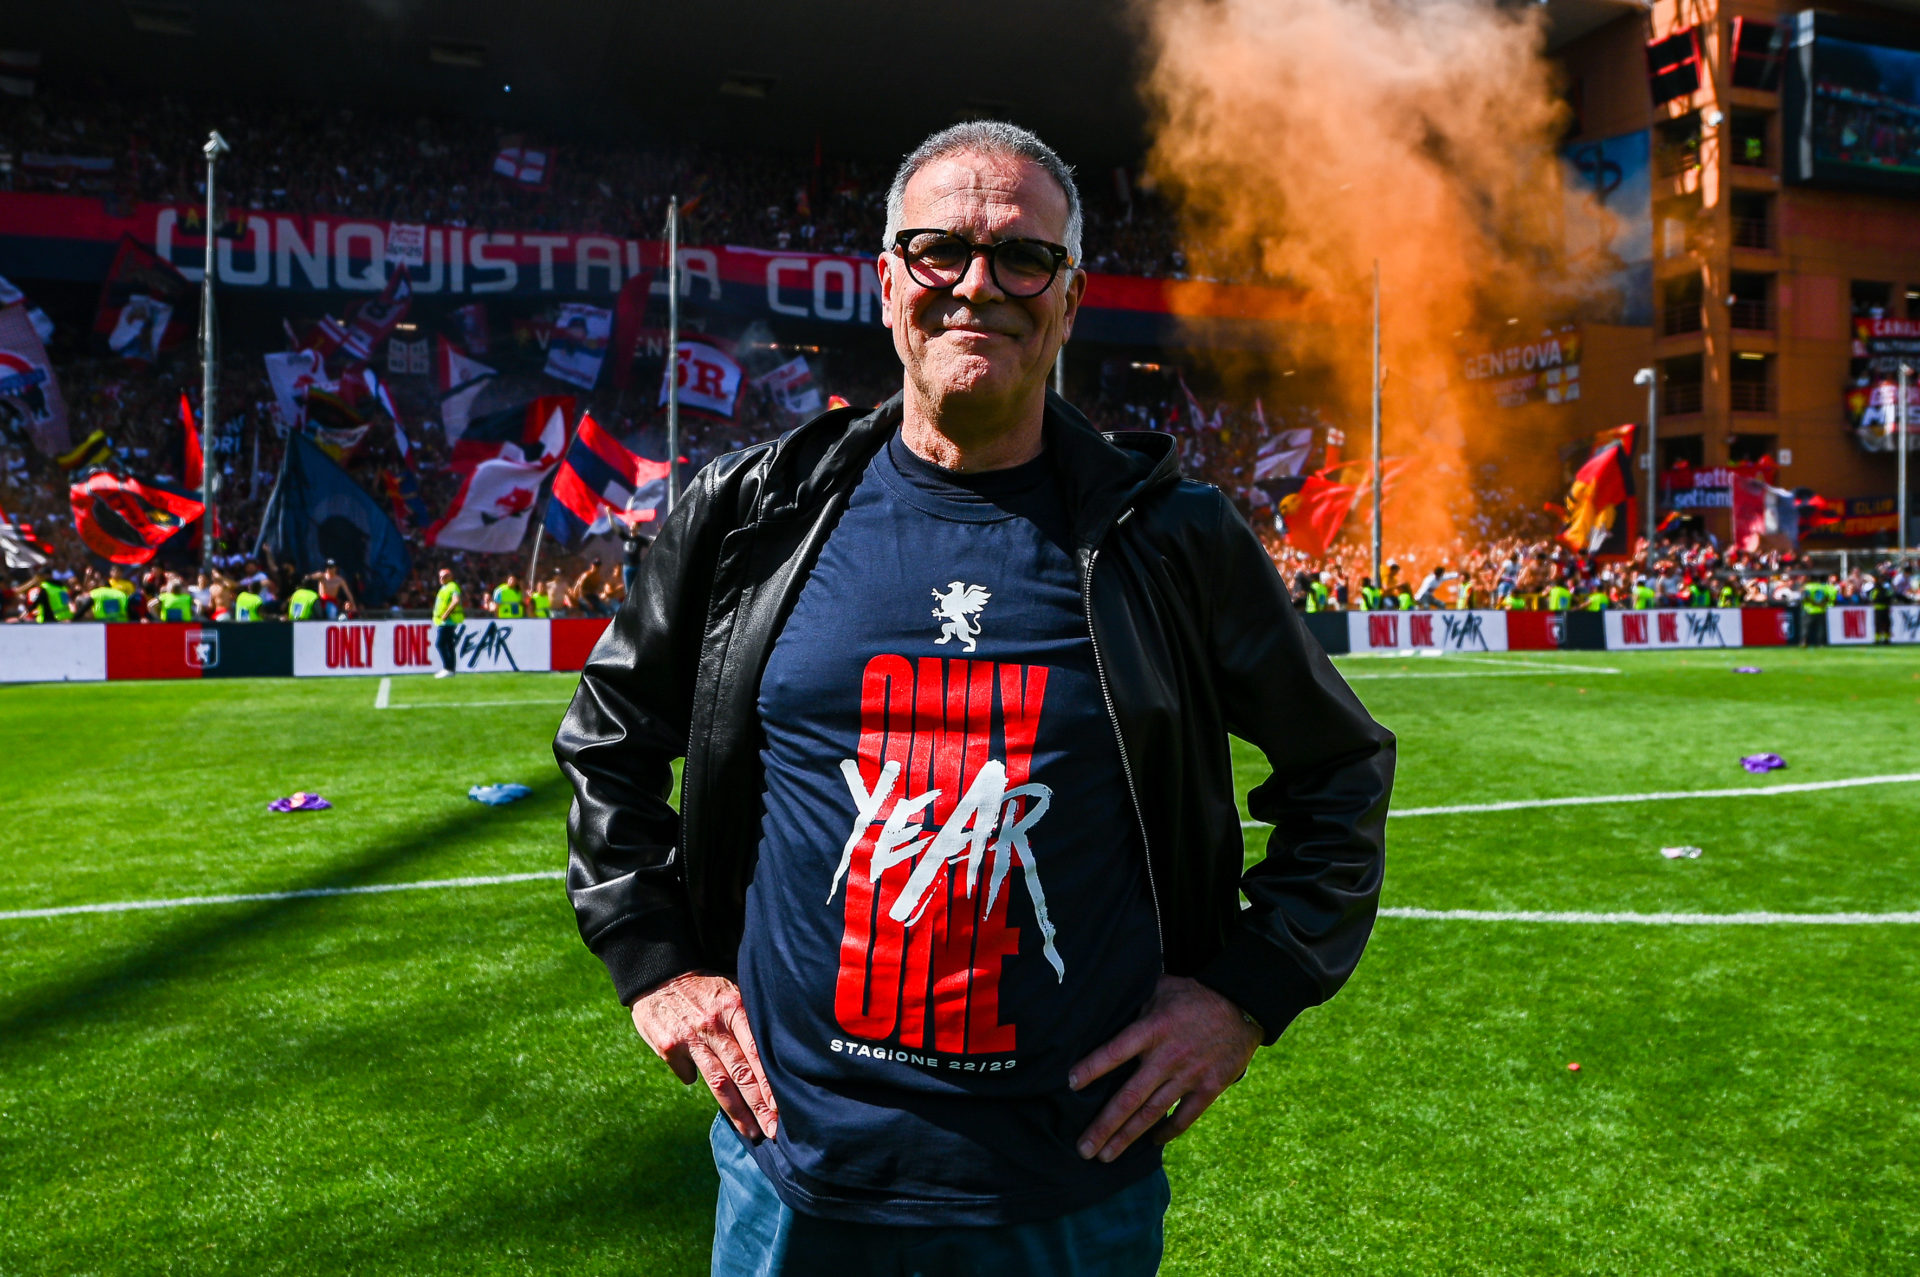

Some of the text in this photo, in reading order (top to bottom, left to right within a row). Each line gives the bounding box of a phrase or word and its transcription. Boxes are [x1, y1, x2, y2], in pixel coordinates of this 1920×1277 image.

[325, 625, 376, 668] ONLY
[393, 623, 432, 666] ONE
[1368, 612, 1489, 651] ONLY ONE YEAR
[1622, 609, 1725, 647] ONLY ONE YEAR
[858, 653, 1049, 827] ONLY
[826, 759, 1066, 985] YEAR
[835, 824, 1032, 1054] ONE
[829, 1037, 1018, 1073] STAGIONE 22/23
